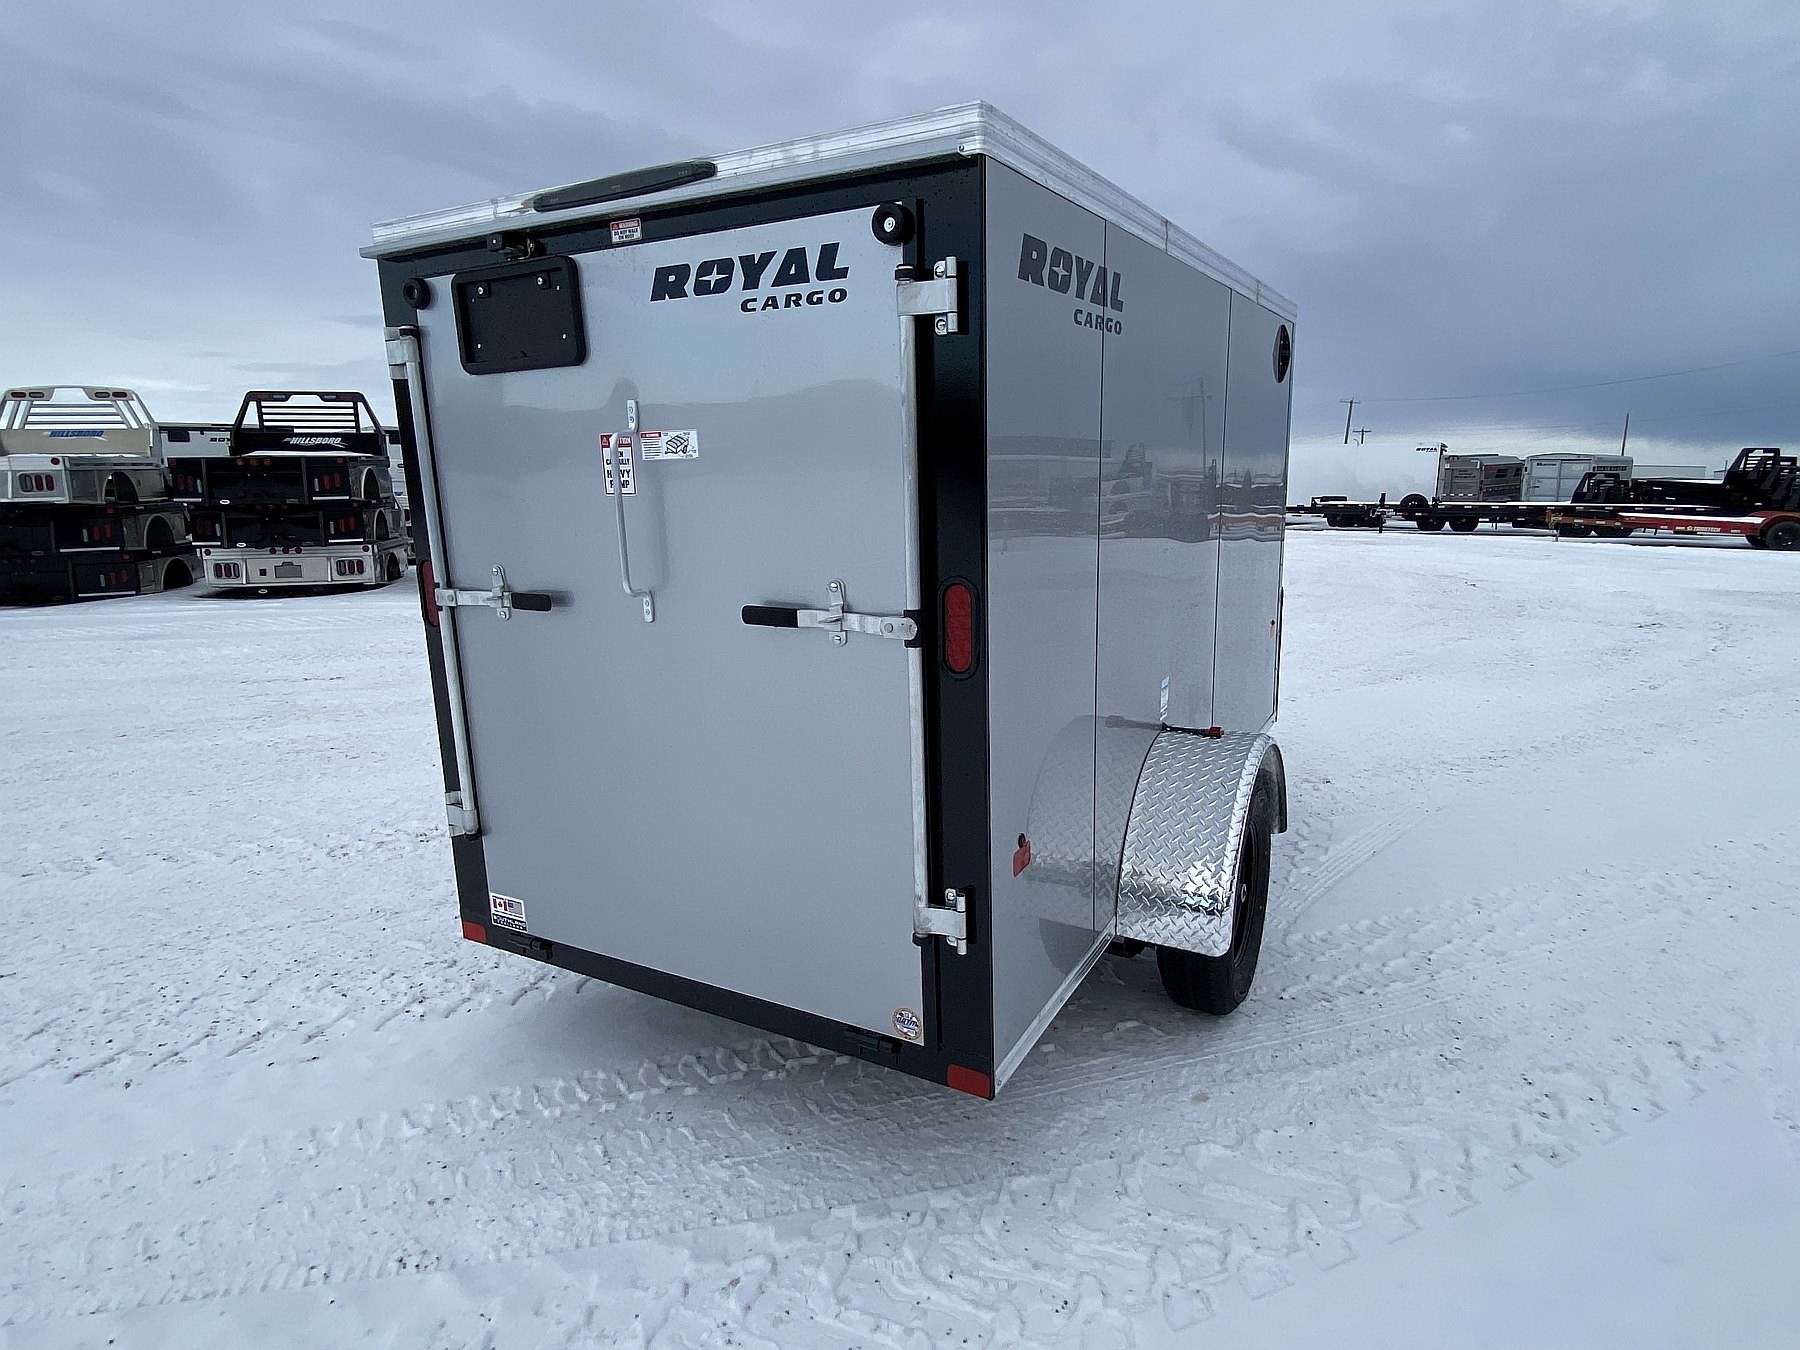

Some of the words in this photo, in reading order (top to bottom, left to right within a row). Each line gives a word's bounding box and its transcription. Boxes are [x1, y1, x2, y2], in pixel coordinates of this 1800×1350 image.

[650, 242, 849, 301] ROYAL
[1018, 233, 1124, 312] ROYAL
[740, 288, 848, 313] CARGO
[1074, 309, 1122, 335] CARGO
